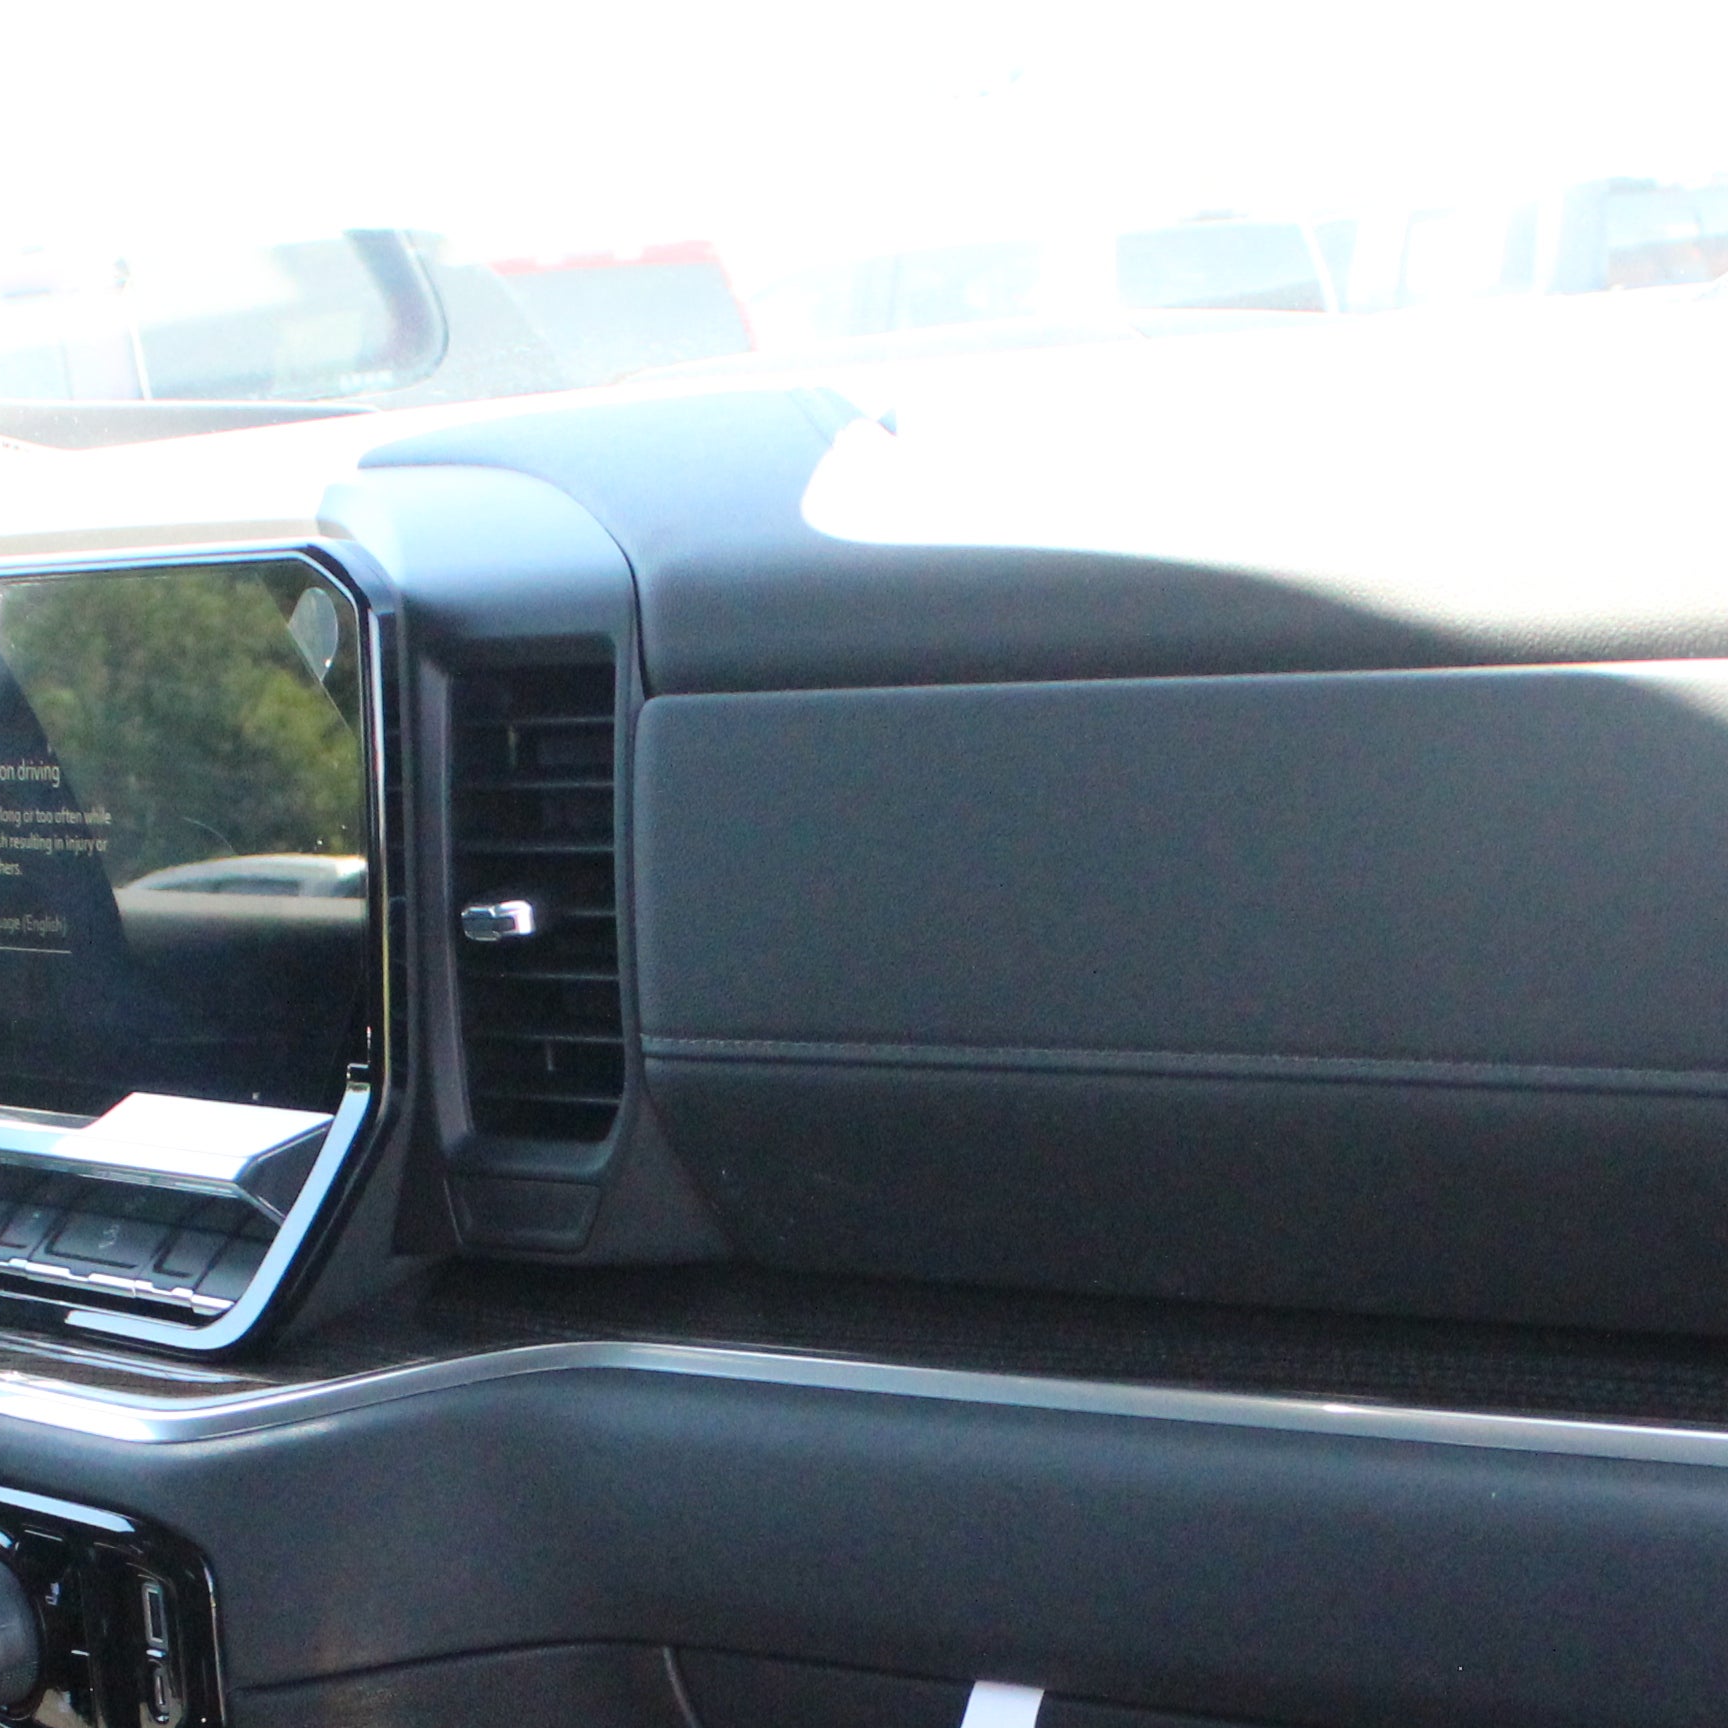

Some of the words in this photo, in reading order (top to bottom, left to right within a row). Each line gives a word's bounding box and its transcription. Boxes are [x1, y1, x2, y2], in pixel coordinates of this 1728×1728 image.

[0, 765, 14, 781] on
[18, 759, 60, 788] driving
[0, 806, 21, 828] long
[24, 810, 34, 823] or
[36, 808, 53, 824] too
[54, 807, 82, 825] often
[85, 806, 112, 825] while
[10, 832, 52, 855] resulting
[54, 835, 63, 850] in
[66, 836, 94, 856] injury
[96, 838, 107, 851] or
[23, 914, 67, 938] (English)
